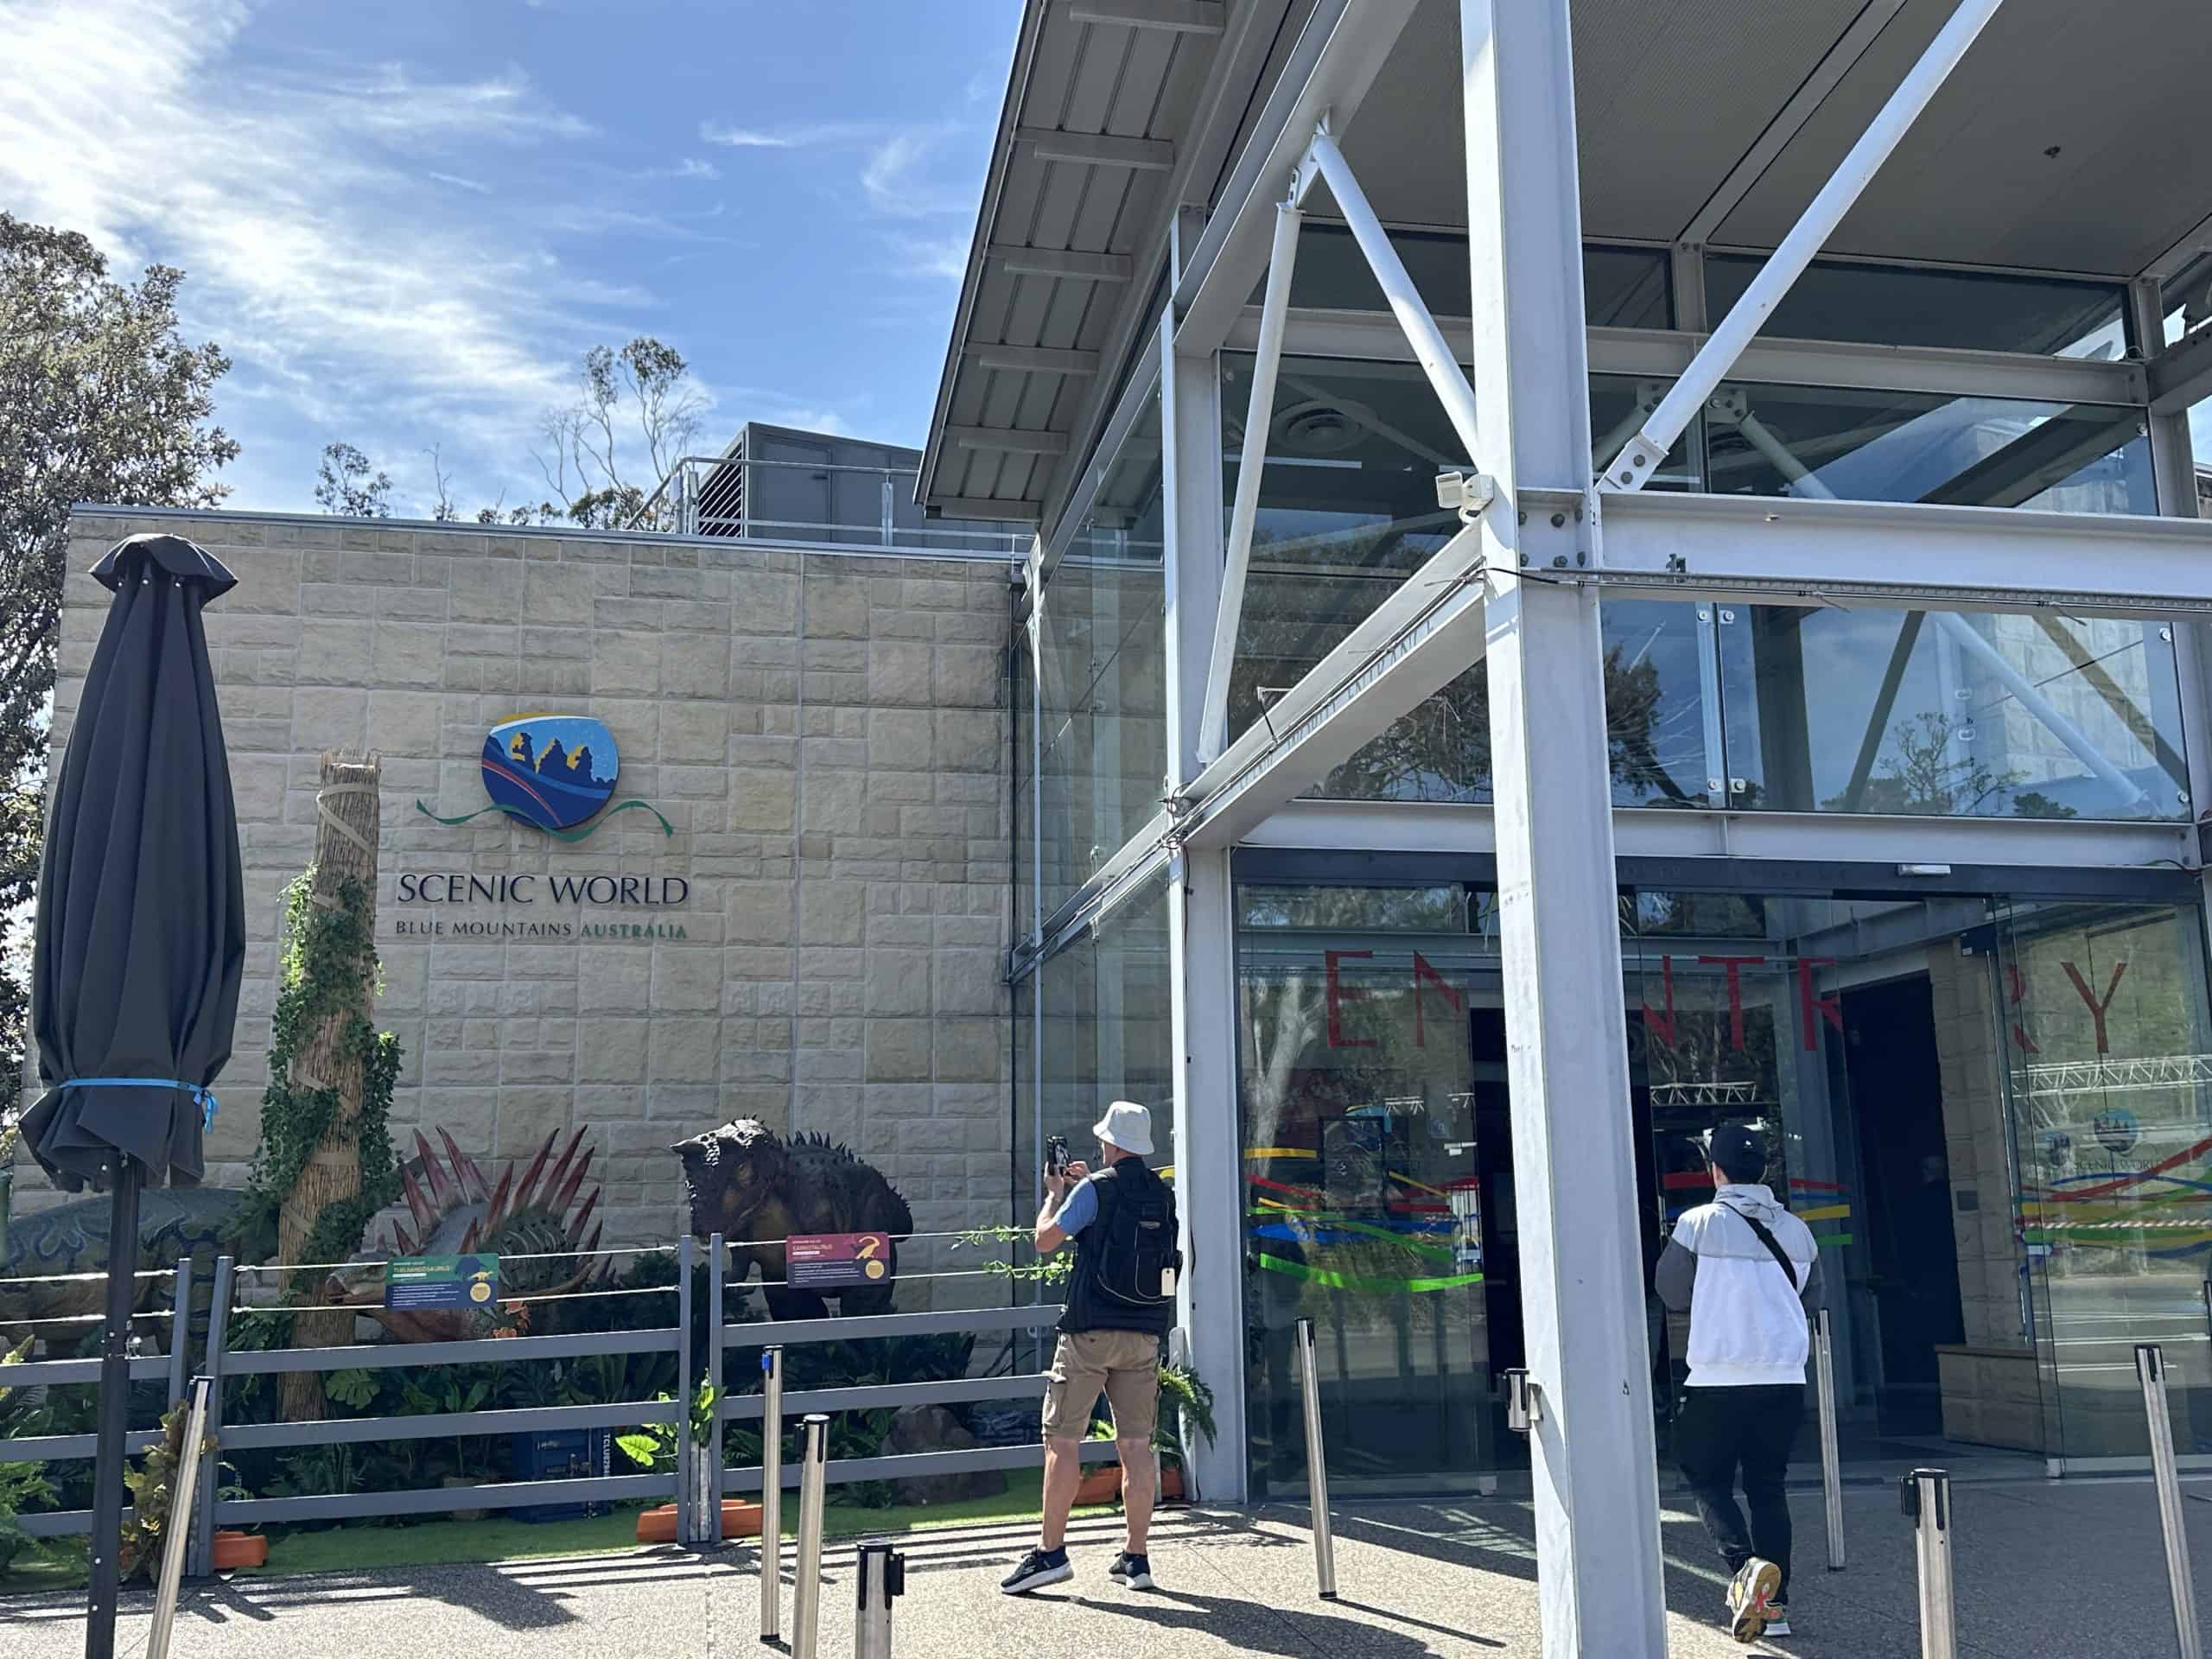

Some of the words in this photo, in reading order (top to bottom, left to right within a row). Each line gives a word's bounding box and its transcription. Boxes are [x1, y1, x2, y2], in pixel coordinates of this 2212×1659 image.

[397, 874, 535, 905] SCENIC
[550, 874, 690, 906] WORLD
[395, 920, 444, 936] BLUE
[452, 921, 573, 938] MOUNTAINS
[581, 922, 689, 940] AUSTRALIA
